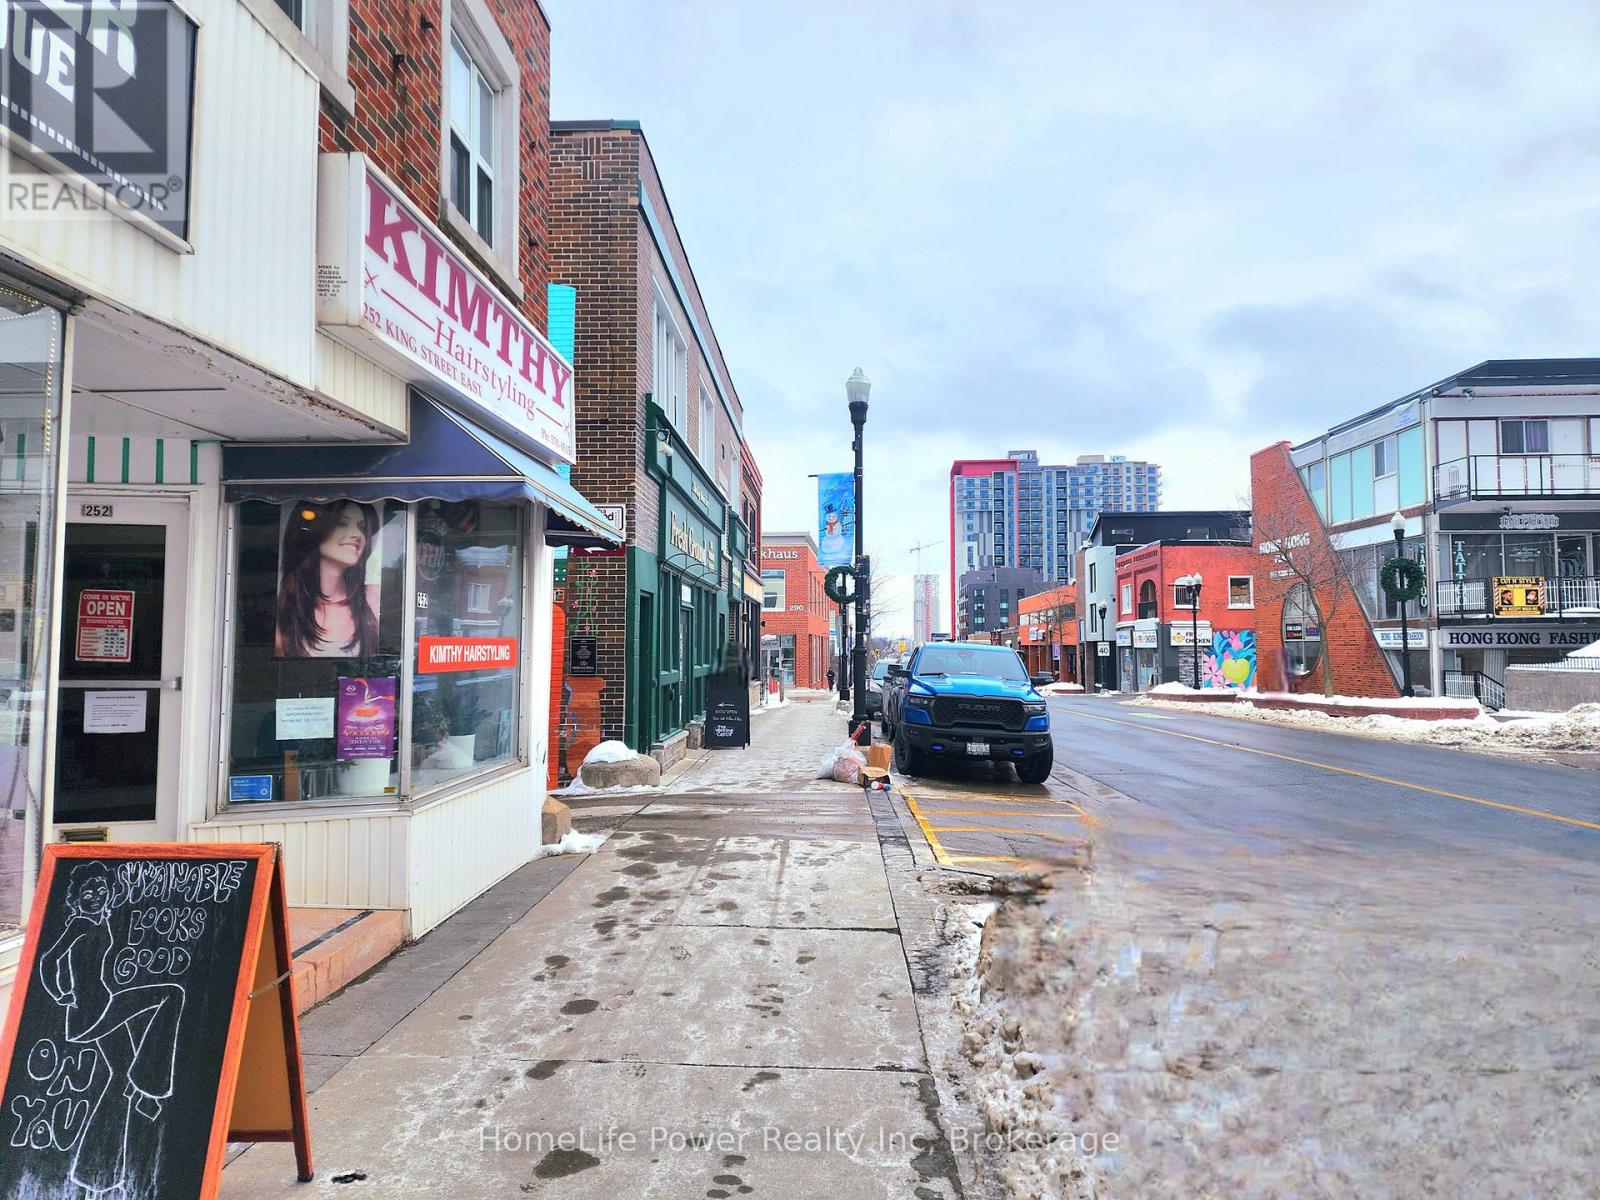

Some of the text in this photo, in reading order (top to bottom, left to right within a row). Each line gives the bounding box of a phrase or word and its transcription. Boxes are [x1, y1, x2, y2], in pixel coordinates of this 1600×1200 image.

[365, 178, 570, 409] KIMTHY
[363, 302, 484, 398] 252 KING STREET EAST
[434, 316, 536, 421] Hairstyling
[85, 504, 110, 517] 252
[87, 600, 126, 616] OPEN
[429, 644, 510, 664] KIMTHY HAIRSTYLING
[1450, 631, 1494, 645] HONG
[1495, 631, 1541, 645] KONG
[128, 907, 207, 946] LOOKS
[113, 946, 191, 985] GOOD
[27, 1038, 97, 1096] ON
[10, 1095, 89, 1152] YOU
